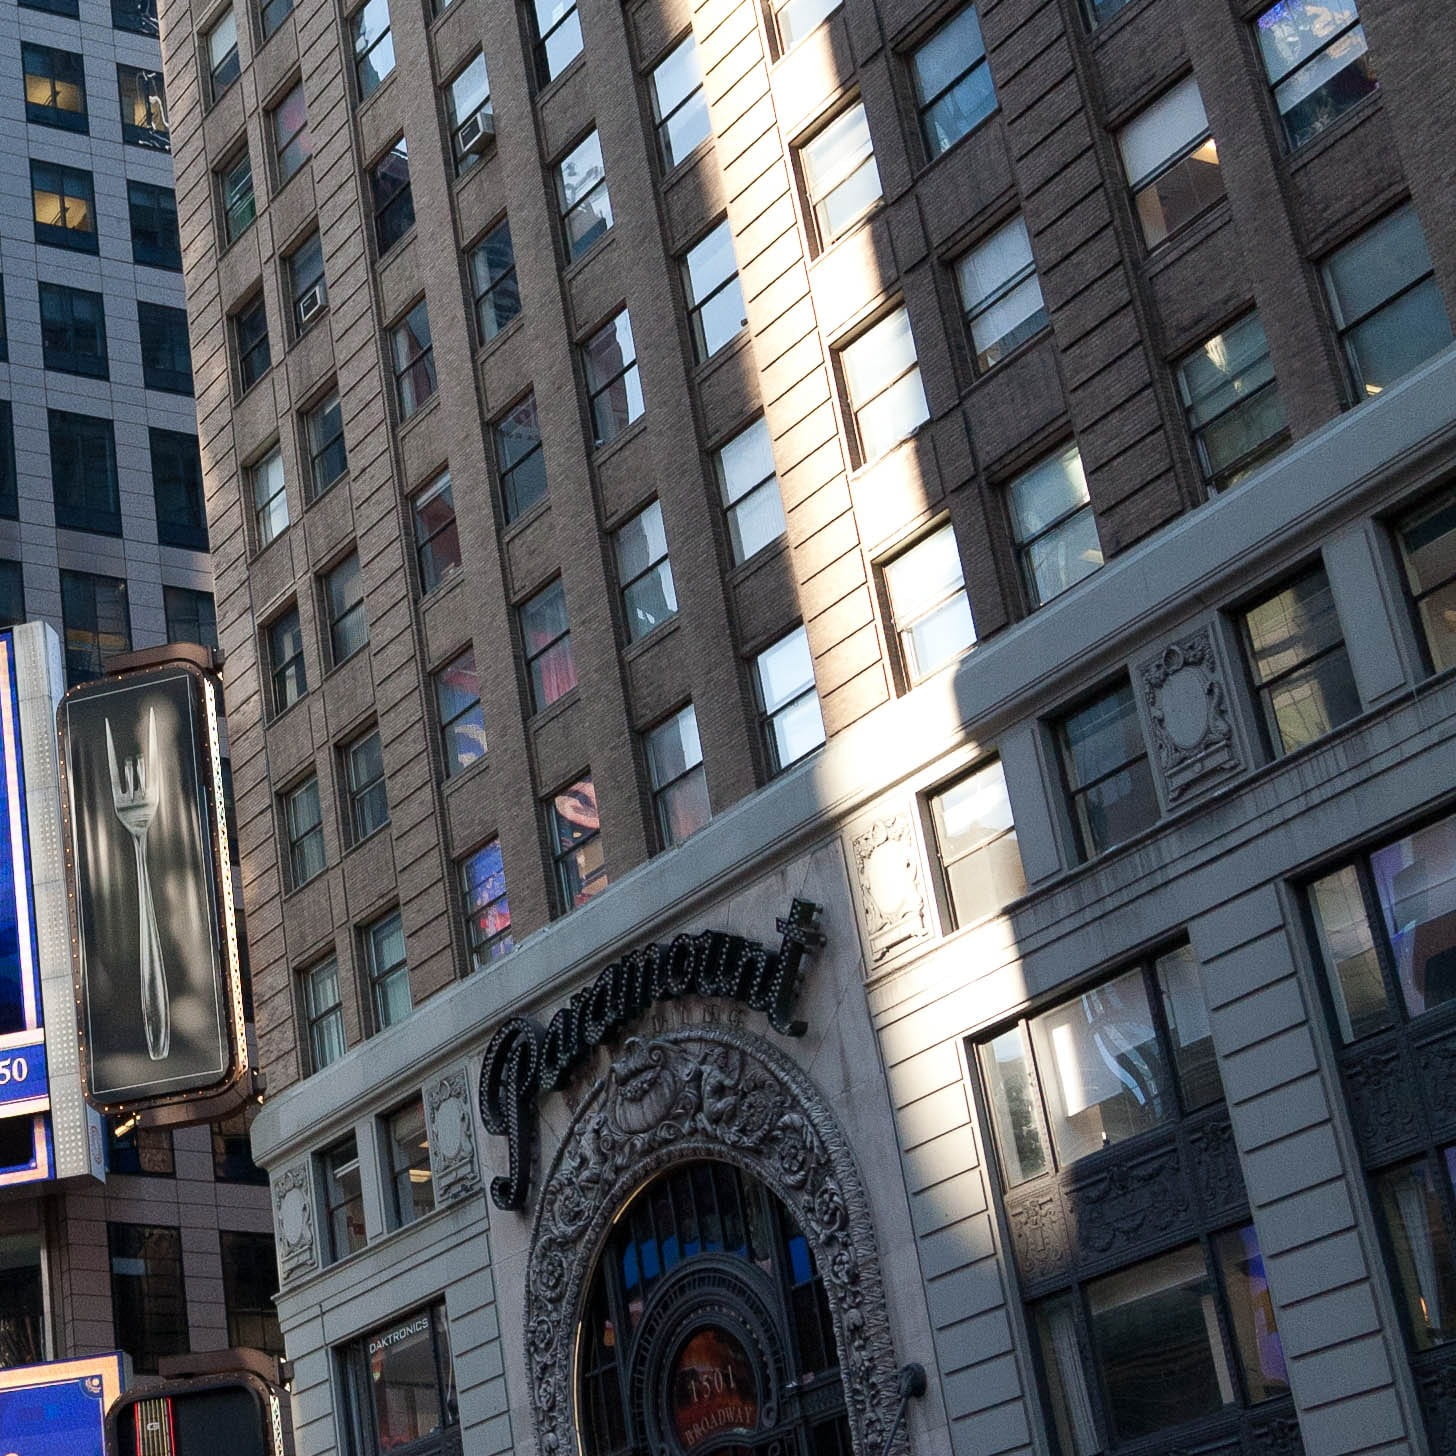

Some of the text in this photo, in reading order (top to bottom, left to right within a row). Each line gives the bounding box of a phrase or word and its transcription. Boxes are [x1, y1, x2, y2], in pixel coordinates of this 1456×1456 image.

[480, 899, 826, 1211] Paramount
[369, 1318, 429, 1354] DAKTRONICS
[691, 1364, 735, 1403] 1501
[685, 1406, 753, 1445] BROADWAY
